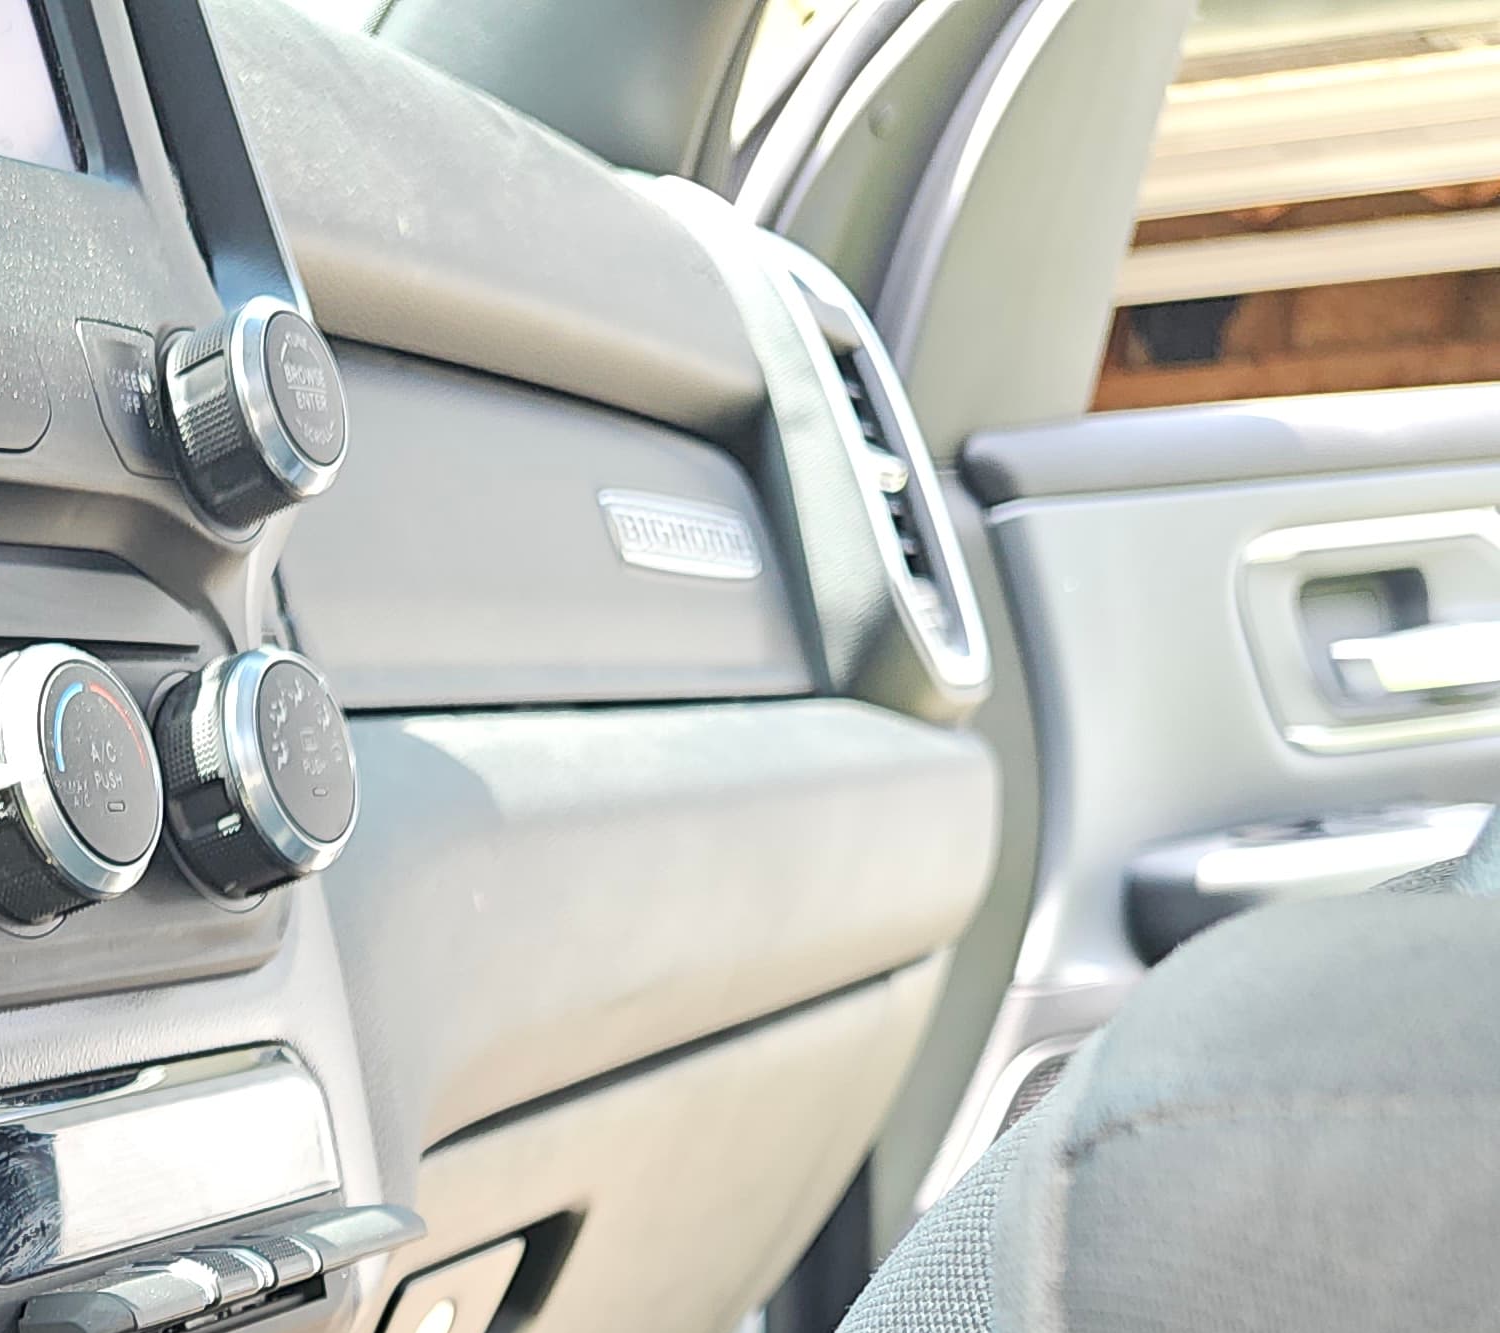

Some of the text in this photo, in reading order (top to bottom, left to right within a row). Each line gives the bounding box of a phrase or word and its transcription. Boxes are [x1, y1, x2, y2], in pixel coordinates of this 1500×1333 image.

[283, 363, 326, 388] BROWSE
[295, 390, 327, 411] ENTER
[613, 512, 749, 559] BIGHORN
[91, 741, 117, 763] A/C
[93, 770, 124, 792] PUSH
